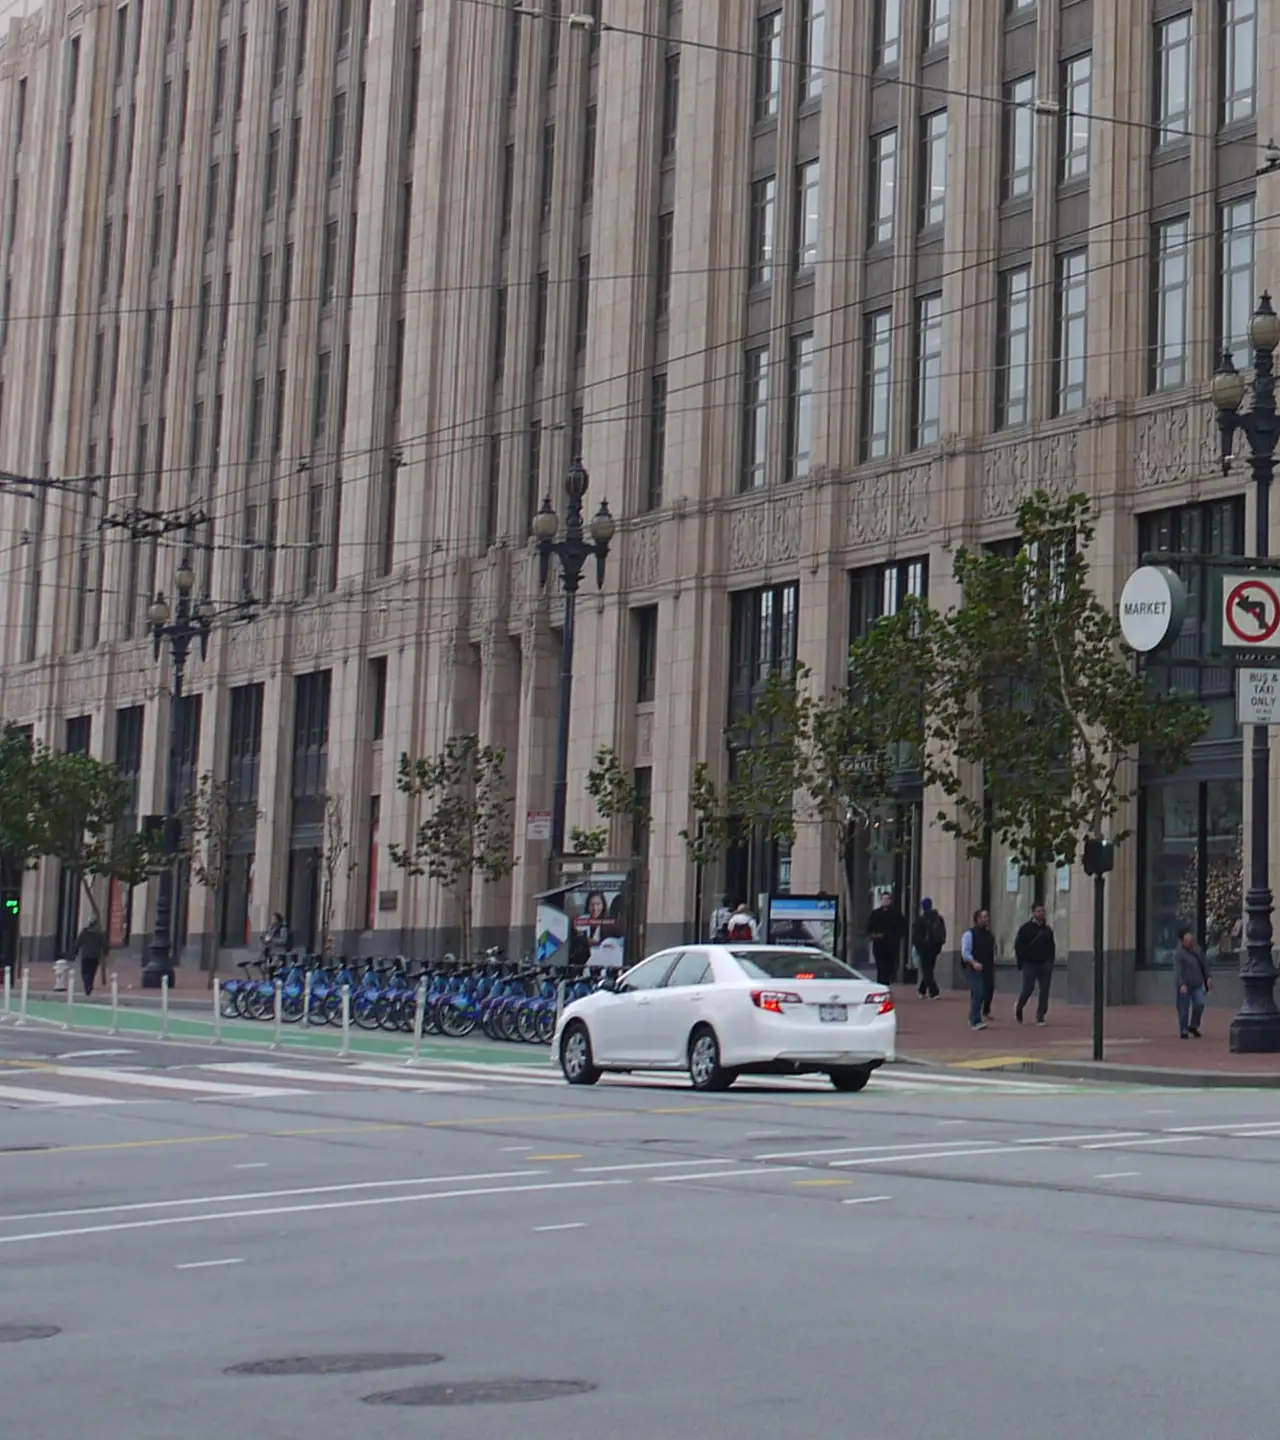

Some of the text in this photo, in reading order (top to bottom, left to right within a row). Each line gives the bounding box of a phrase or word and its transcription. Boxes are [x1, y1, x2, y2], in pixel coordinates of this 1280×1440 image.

[1124, 601, 1167, 615] MARKET
[1250, 672, 1269, 682] BUS
[1251, 696, 1277, 706] ONLY
